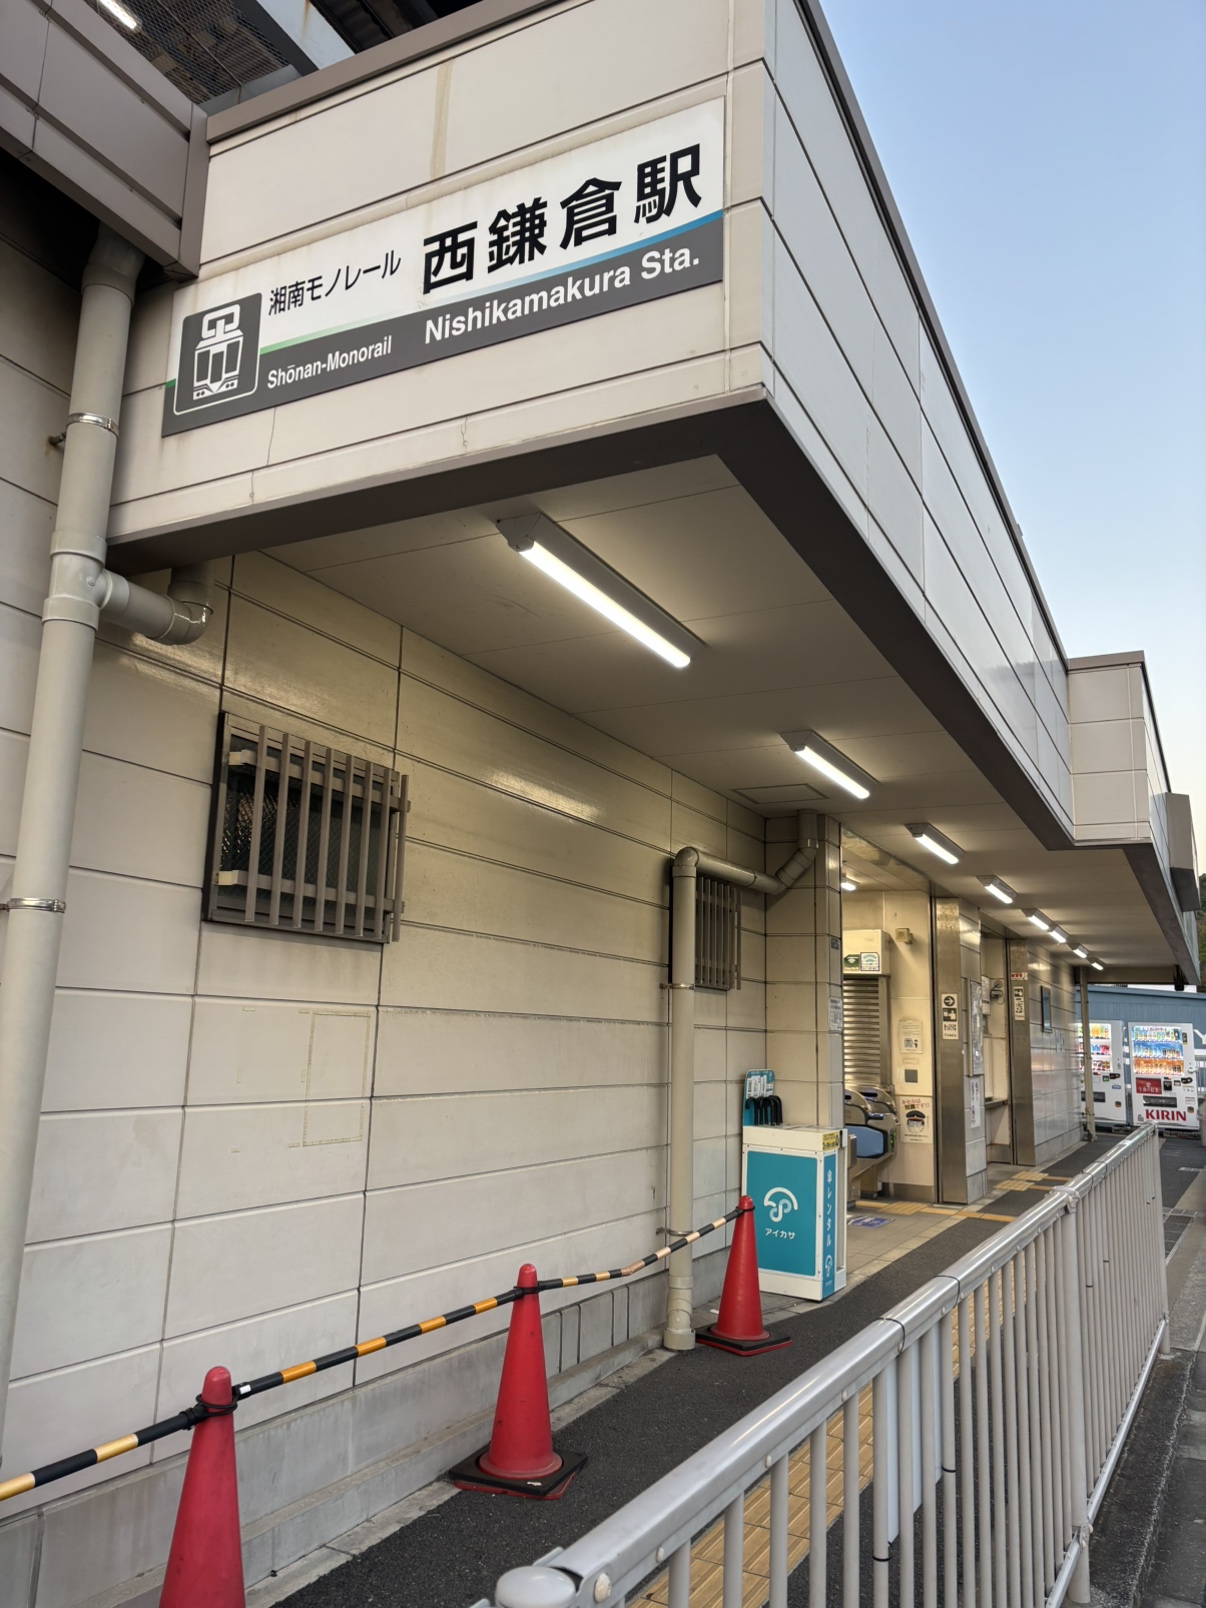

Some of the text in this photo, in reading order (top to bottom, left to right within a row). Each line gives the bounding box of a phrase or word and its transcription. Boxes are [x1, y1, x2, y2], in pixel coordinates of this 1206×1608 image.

[423, 143, 702, 294] 西鎌倉駅
[268, 249, 402, 316] 湘南モノレール
[424, 247, 700, 345] Nishikamakura Sta.
[266, 335, 393, 389] Shōnan-Monorail
[1145, 1109, 1187, 1121] KIRIN
[765, 1228, 796, 1239] アイカサ
